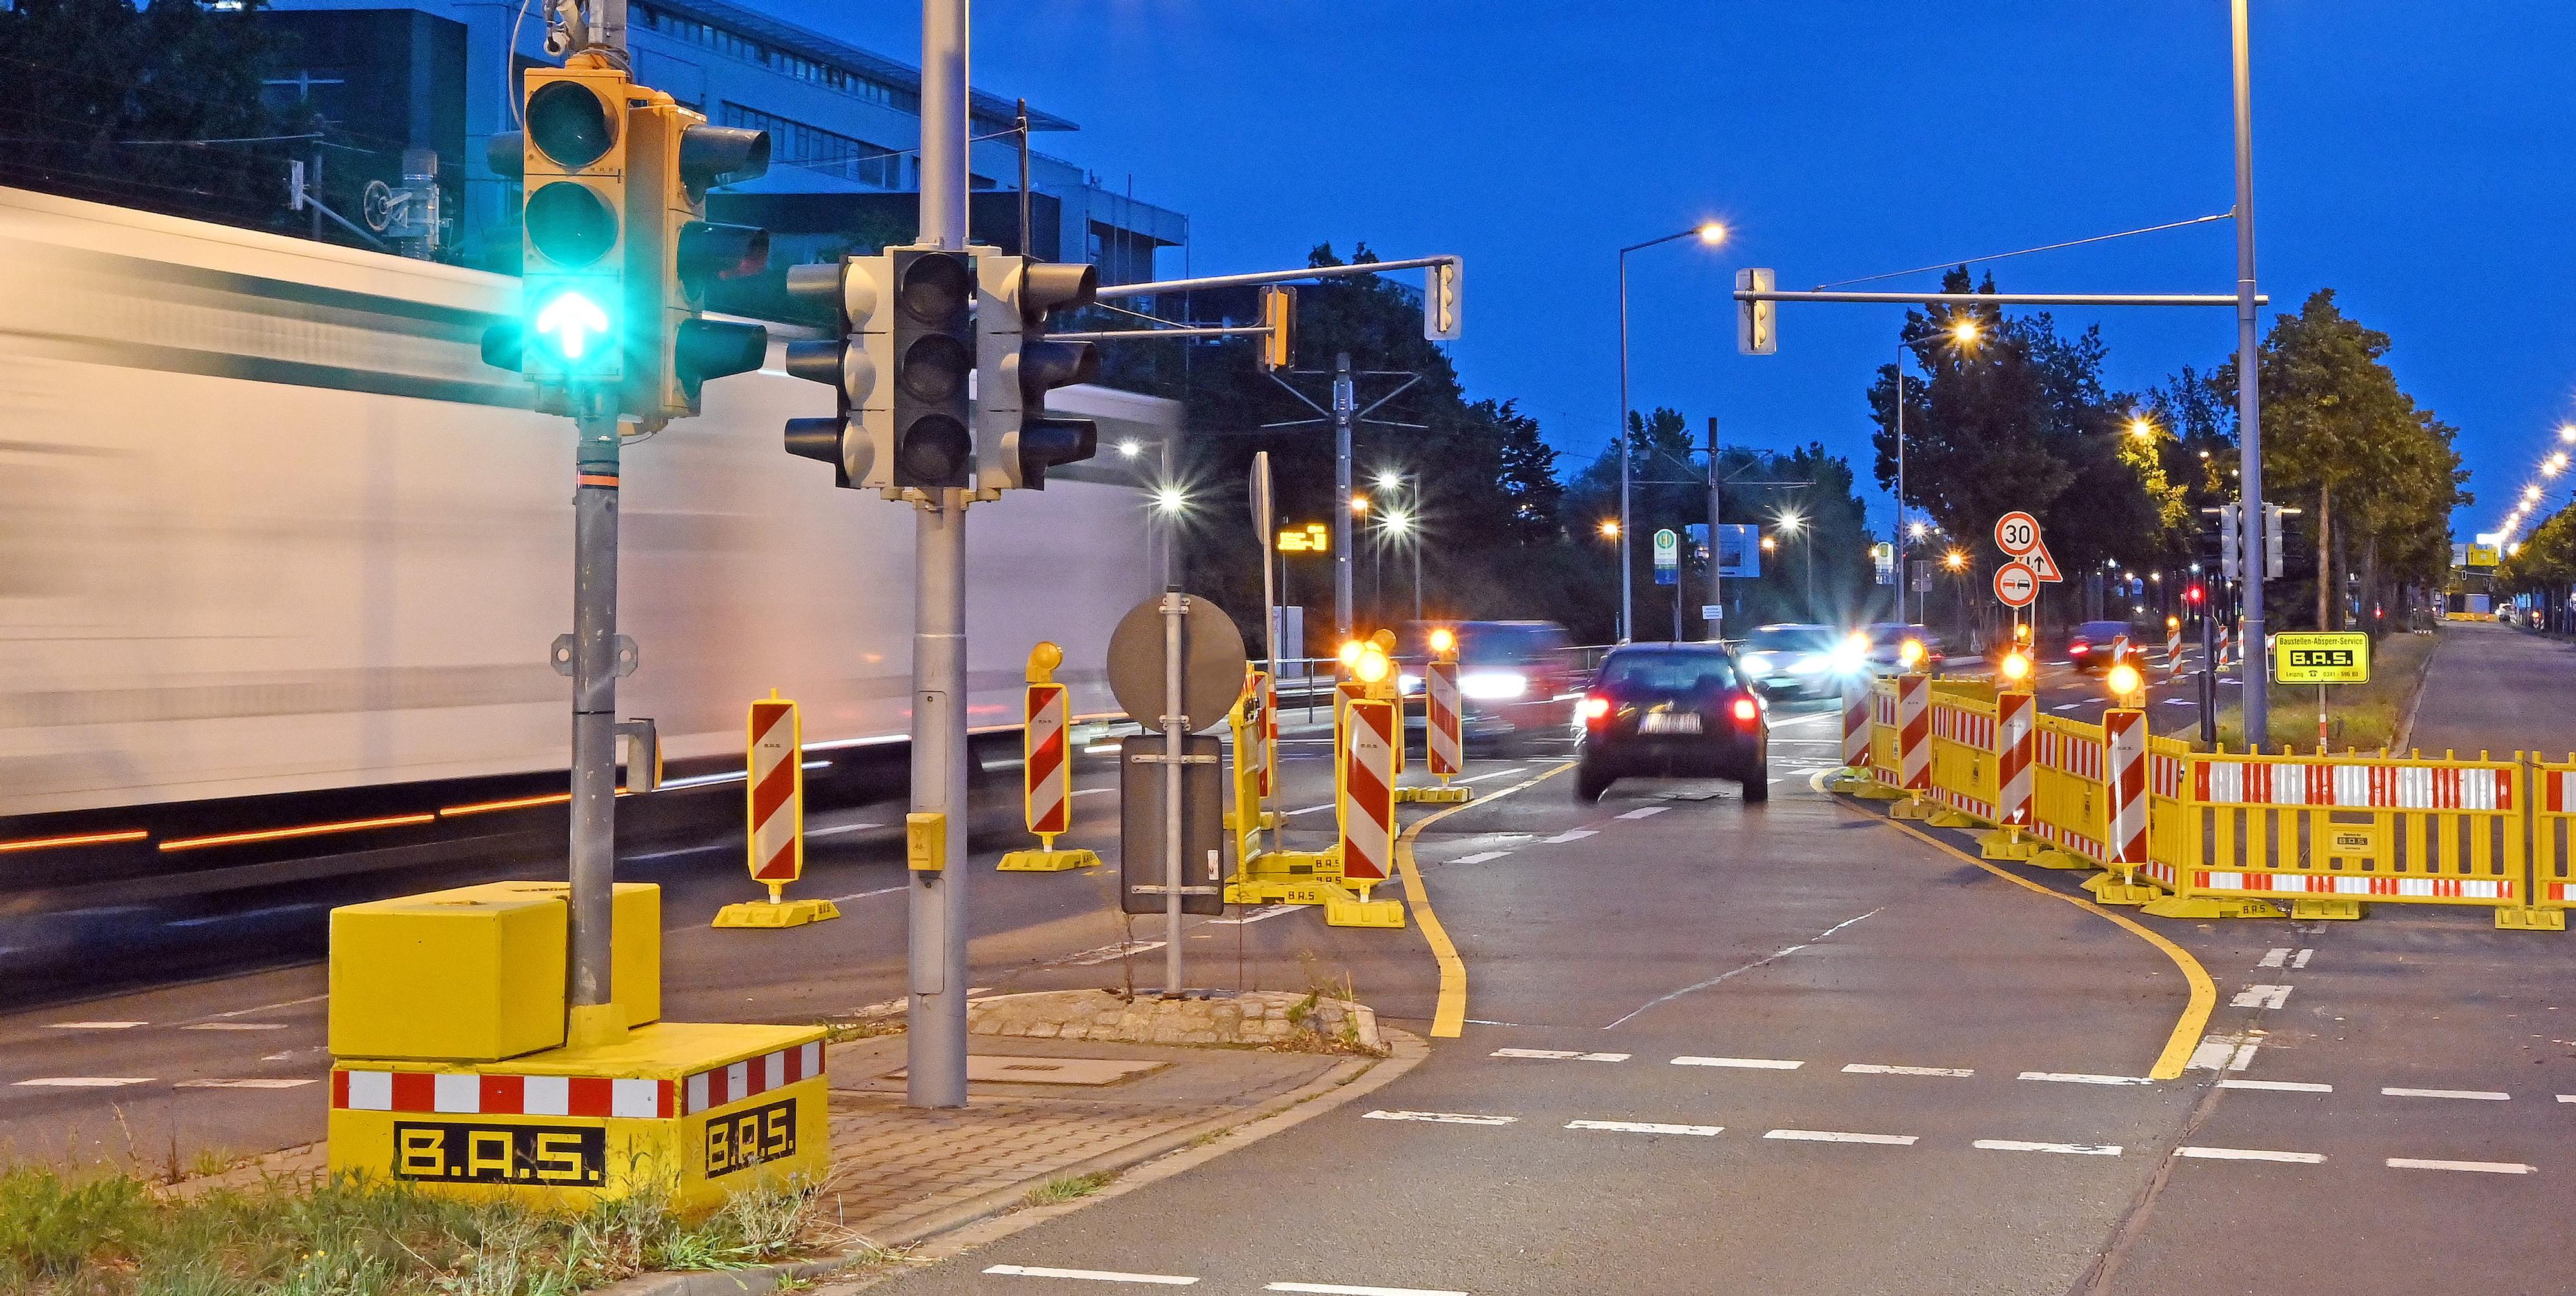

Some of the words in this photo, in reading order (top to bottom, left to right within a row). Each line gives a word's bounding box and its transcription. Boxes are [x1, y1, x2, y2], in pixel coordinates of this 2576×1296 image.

[2005, 525, 2030, 544] 30
[2279, 637, 2363, 646] Baustellen-Absperr-Service
[2292, 652, 2352, 665] B.A.S.
[708, 1107, 793, 1172] B.A.S.
[401, 1128, 599, 1181] B.A.S.
